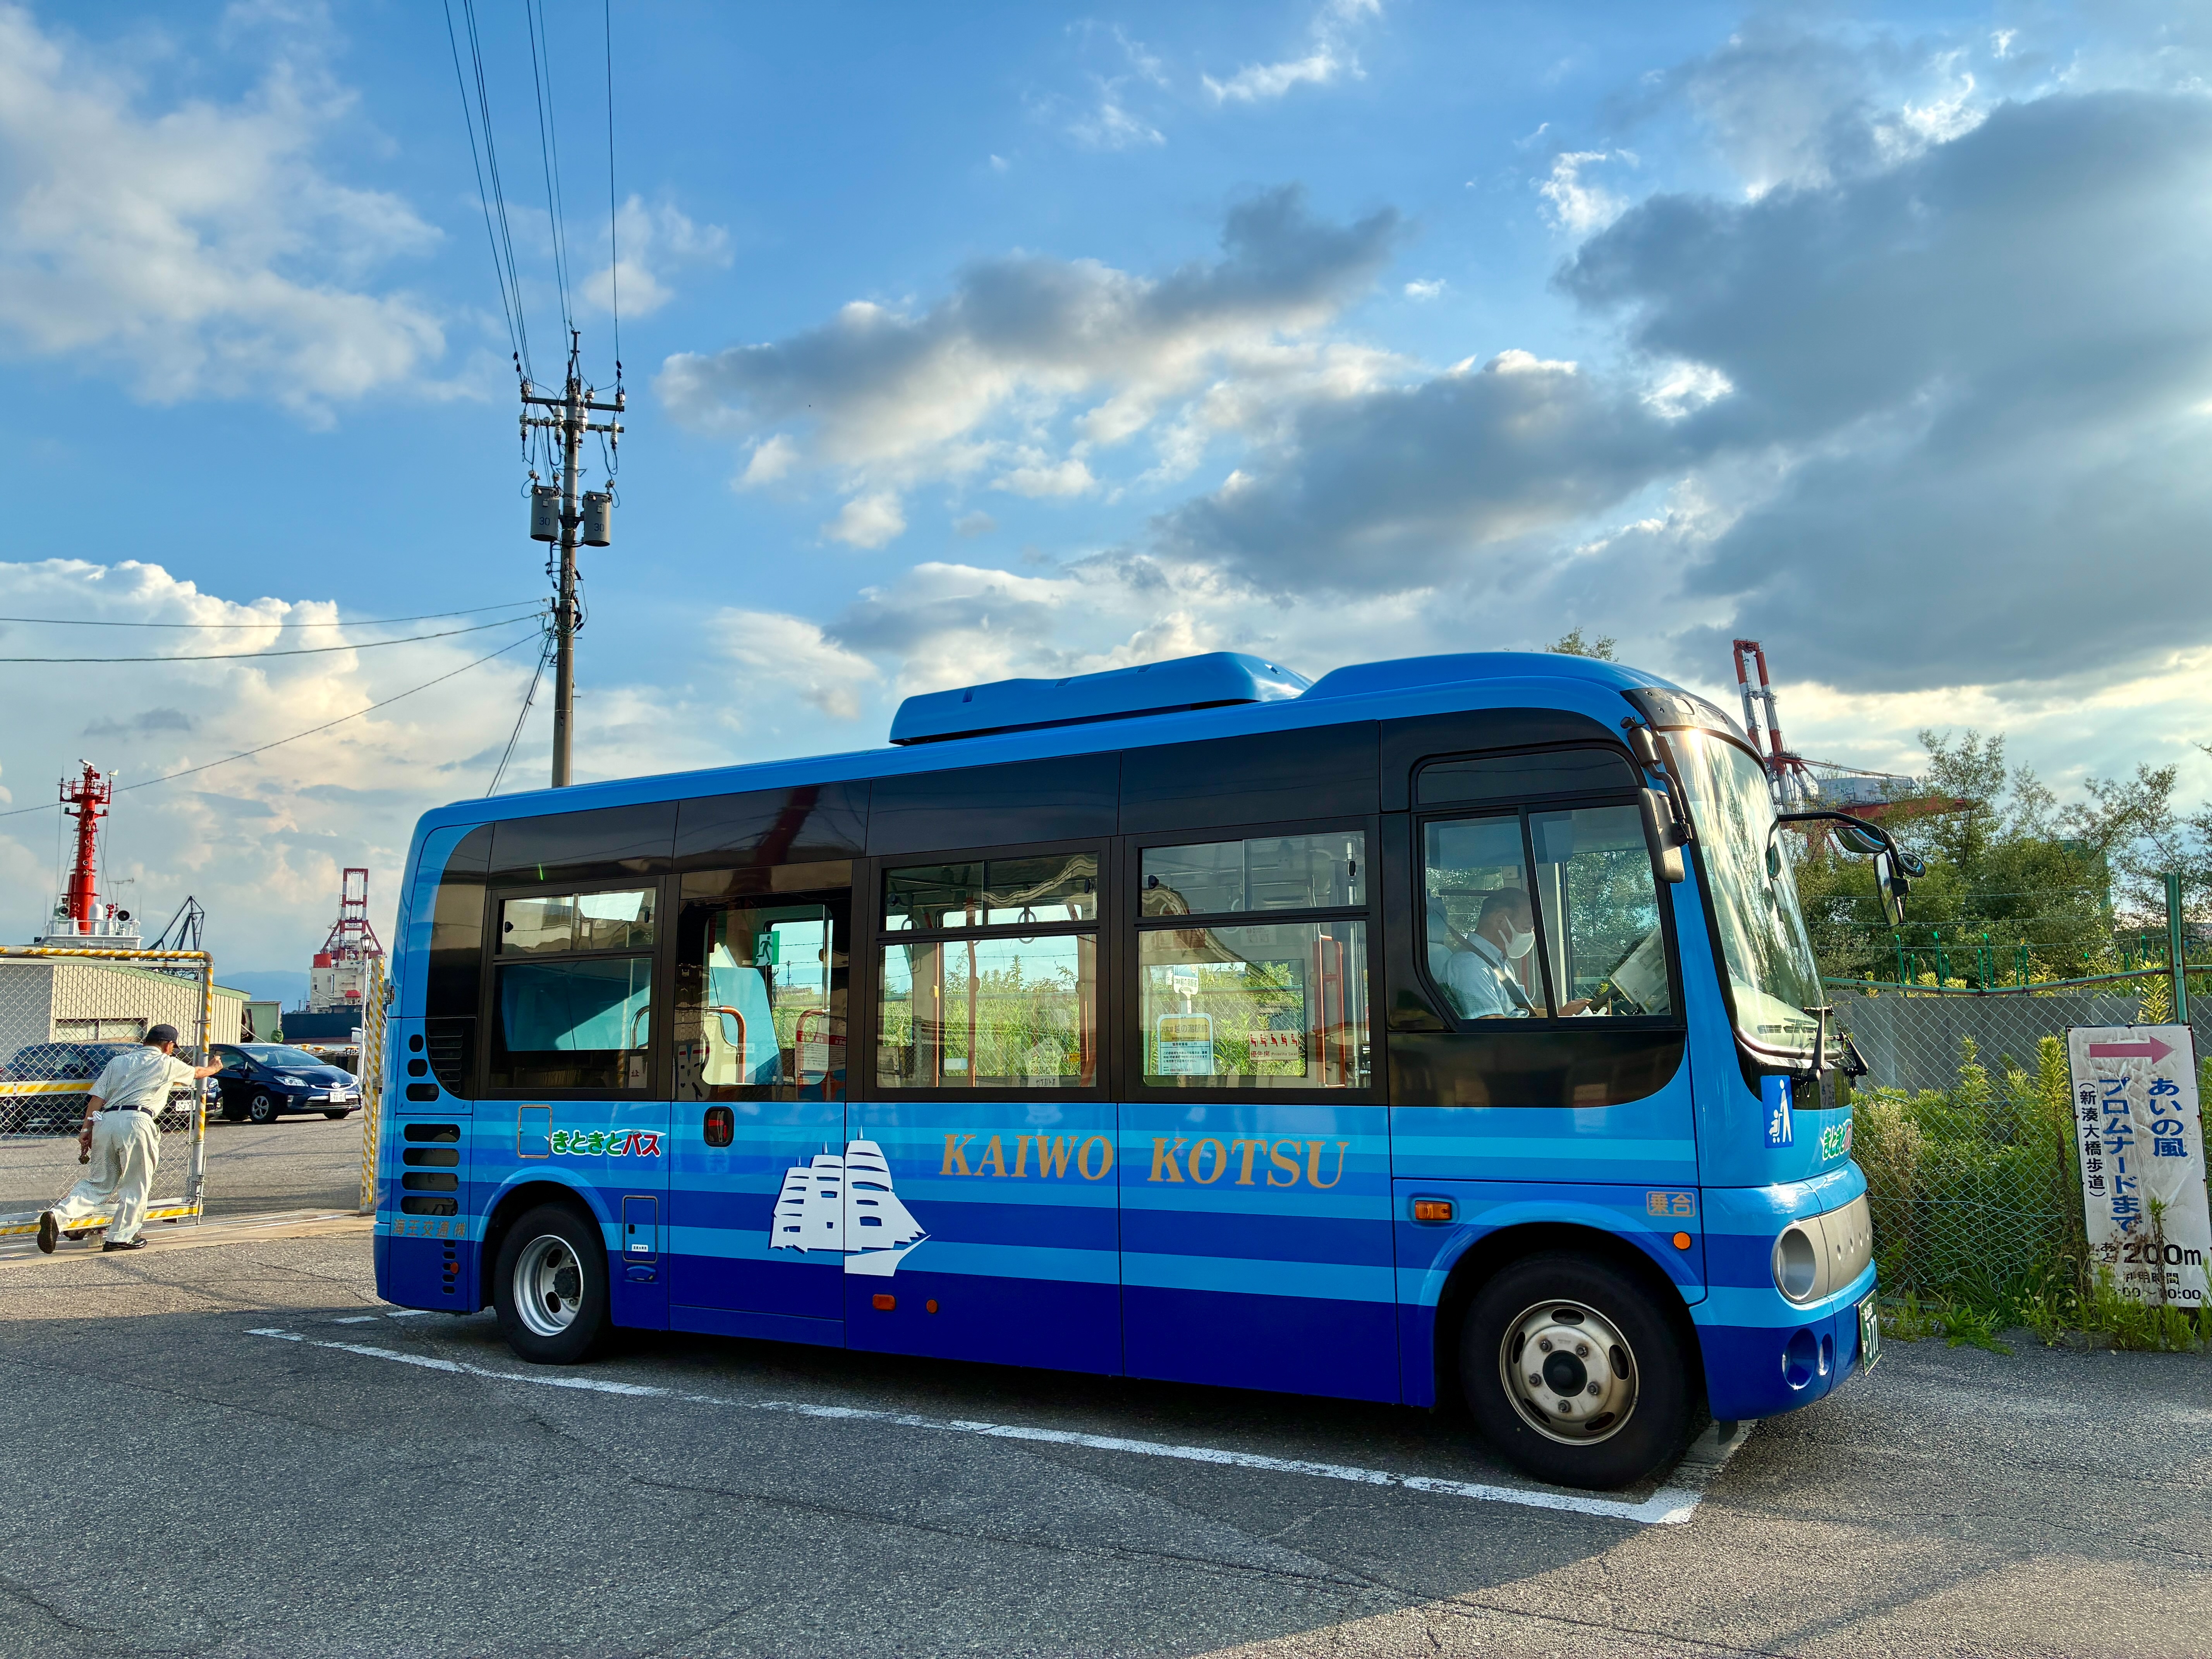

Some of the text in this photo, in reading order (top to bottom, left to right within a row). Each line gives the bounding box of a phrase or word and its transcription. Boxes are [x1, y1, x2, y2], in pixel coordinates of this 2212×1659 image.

[539, 517, 550, 526] 30
[594, 523, 605, 532] 30
[2148, 1077, 2188, 1158] あいの風
[552, 1130, 661, 1157] きときとバス
[2099, 1076, 2143, 1232] プロムナードまで
[939, 1133, 1350, 1188] KAIWO KOTSU
[1650, 1194, 1692, 1215] 乗合
